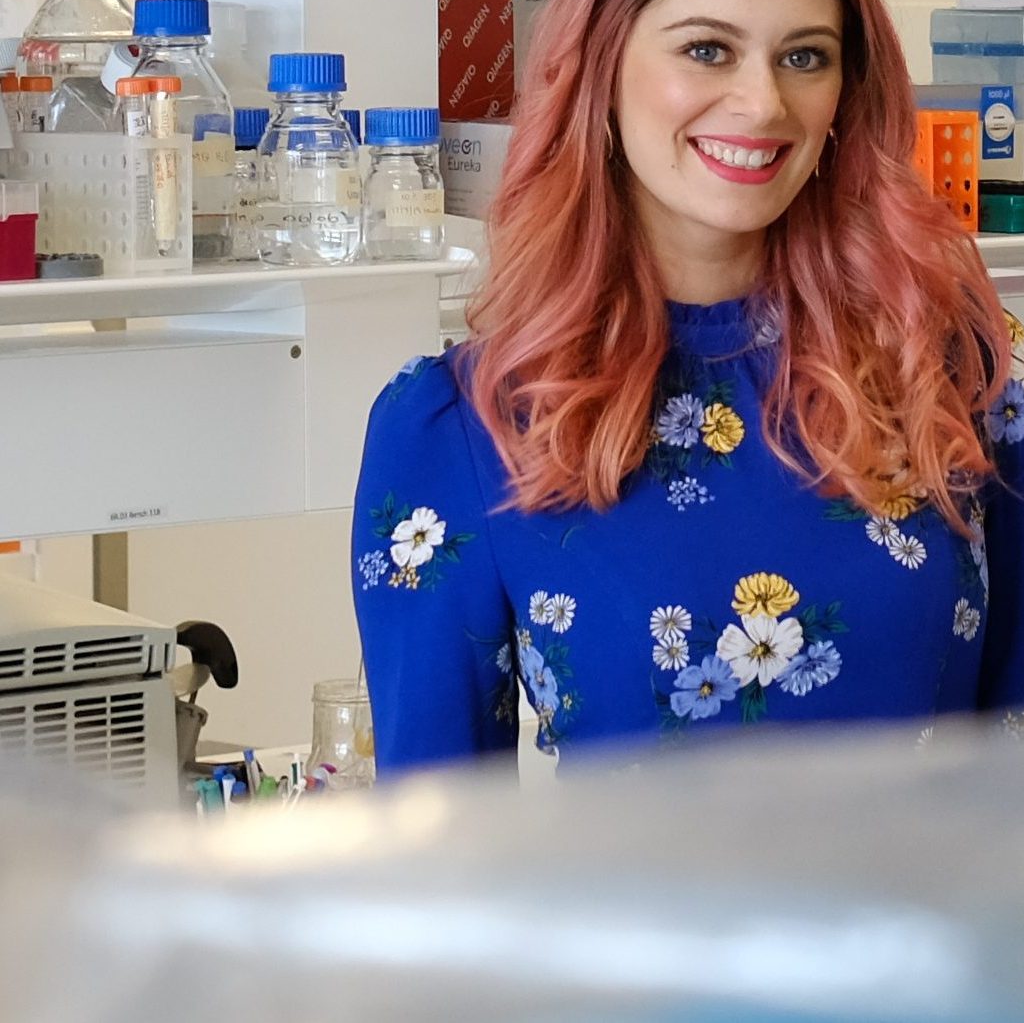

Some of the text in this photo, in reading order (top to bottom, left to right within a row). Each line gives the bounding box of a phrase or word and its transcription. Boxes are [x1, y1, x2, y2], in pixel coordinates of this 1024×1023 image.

[462, 3, 491, 48] QIAGEN
[486, 39, 514, 83] QIAGEN
[448, 64, 476, 108] QIAGEN
[447, 156, 481, 172] Eureka
